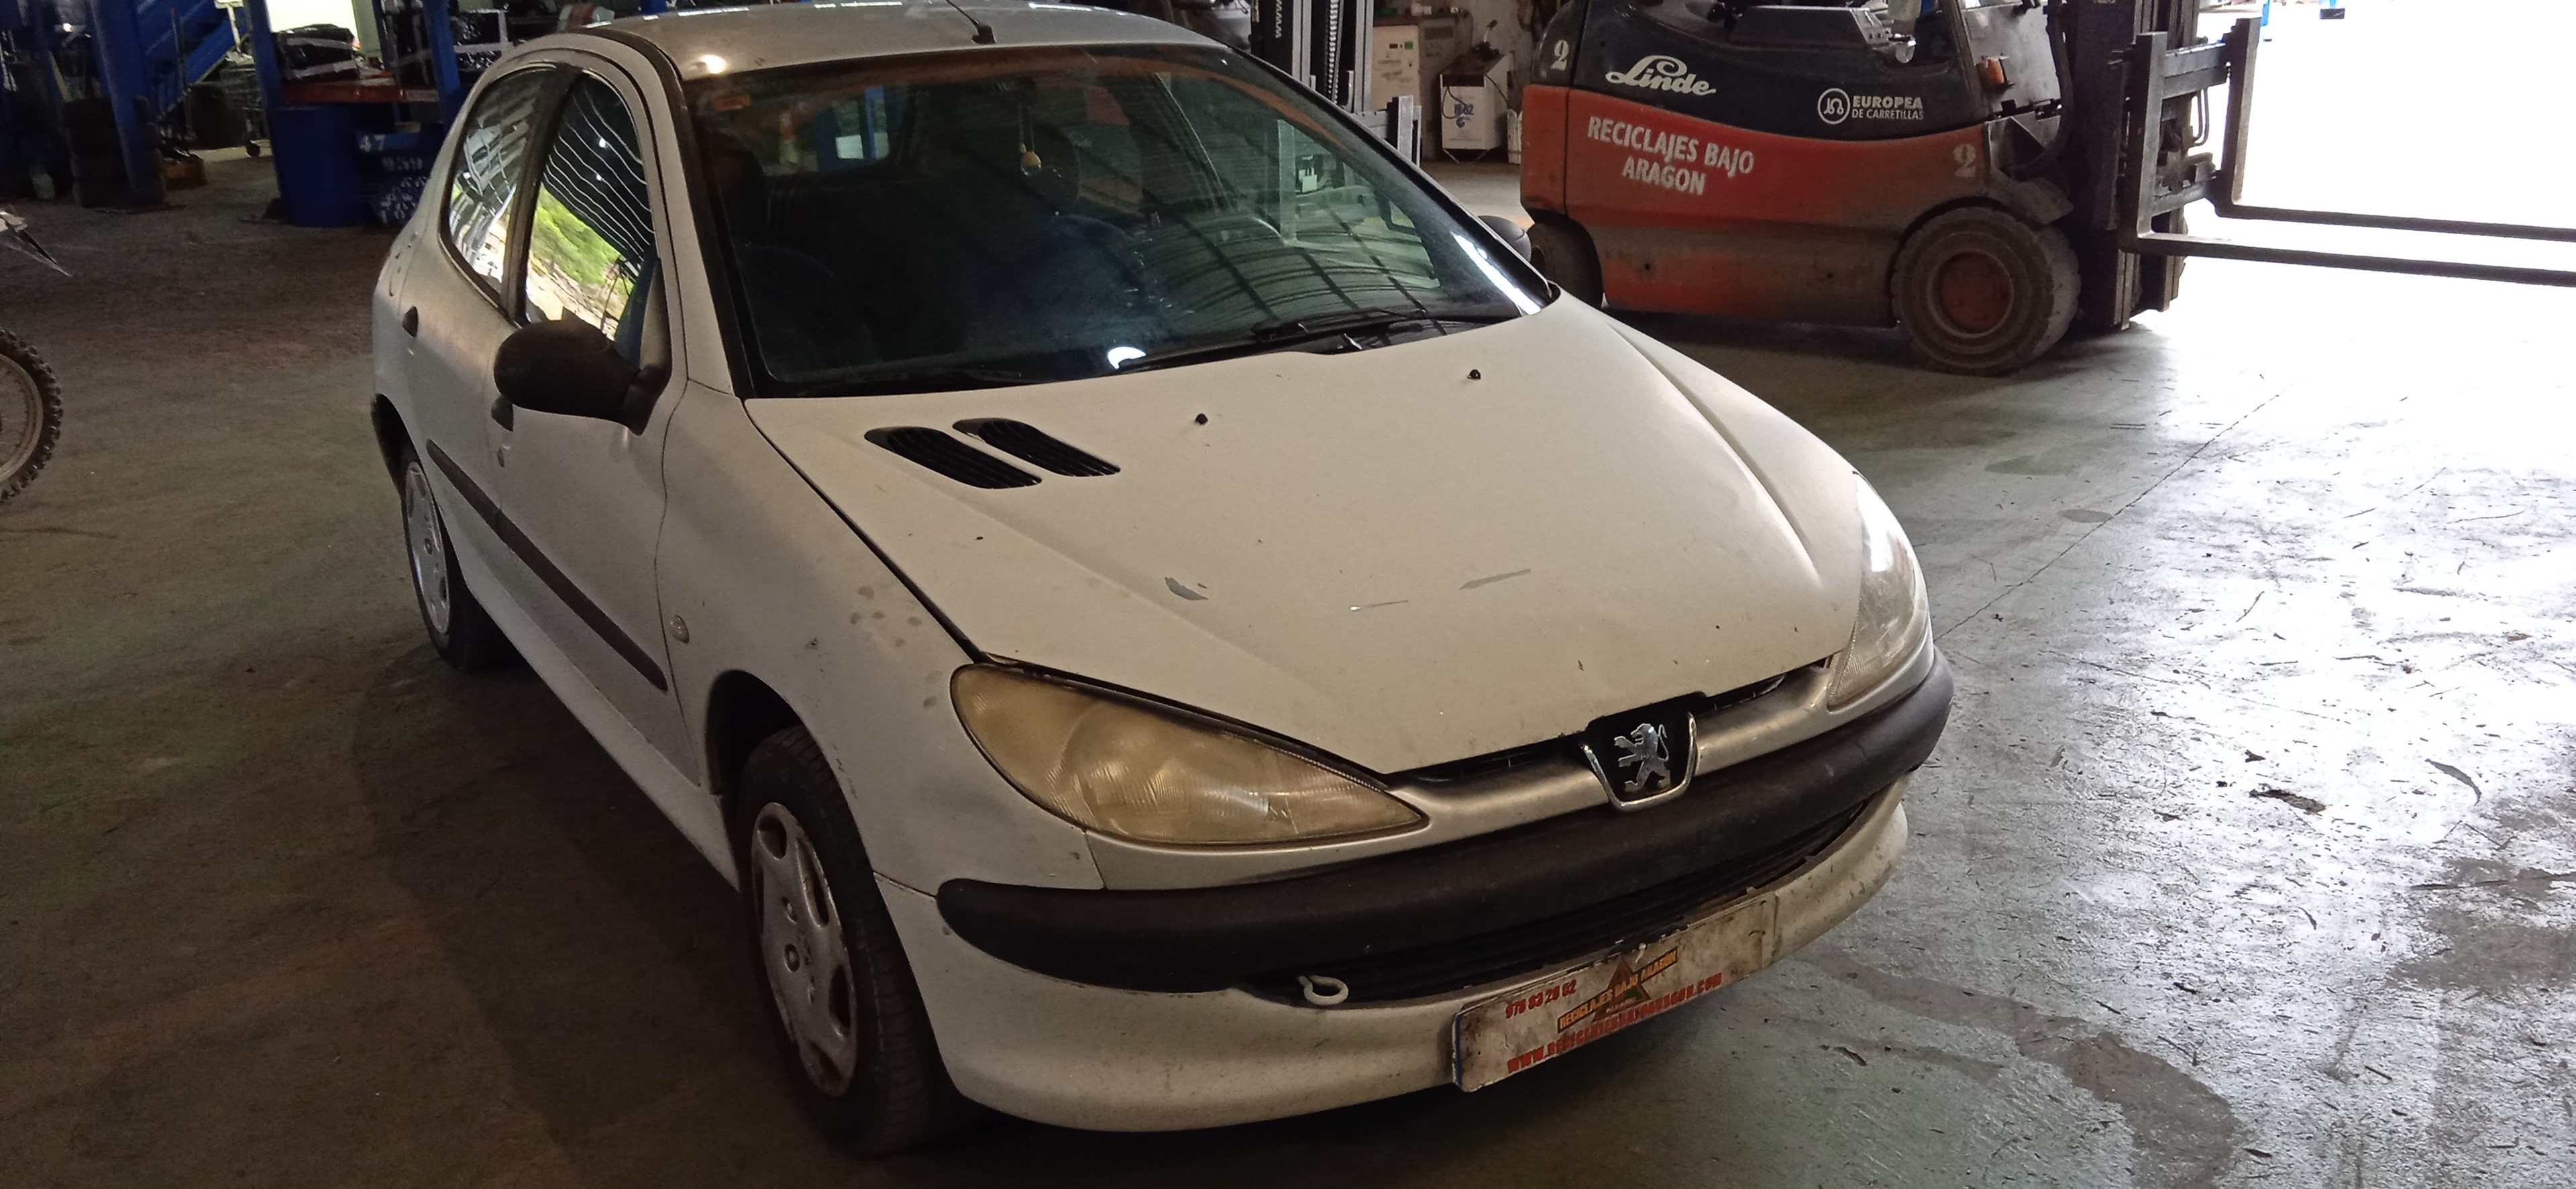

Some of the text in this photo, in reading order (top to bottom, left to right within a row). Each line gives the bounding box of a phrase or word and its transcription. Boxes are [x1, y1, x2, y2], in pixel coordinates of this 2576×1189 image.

[1551, 40, 1570, 70] 2
[1605, 55, 1716, 95] Linde
[1851, 109, 1925, 120] DE CARRETILLAS
[1852, 95, 1923, 109] EUROPEA
[1587, 115, 1755, 178] RECICLAJES BAJO
[1953, 144, 1976, 178] 2
[1621, 156, 1707, 196] ARAGON
